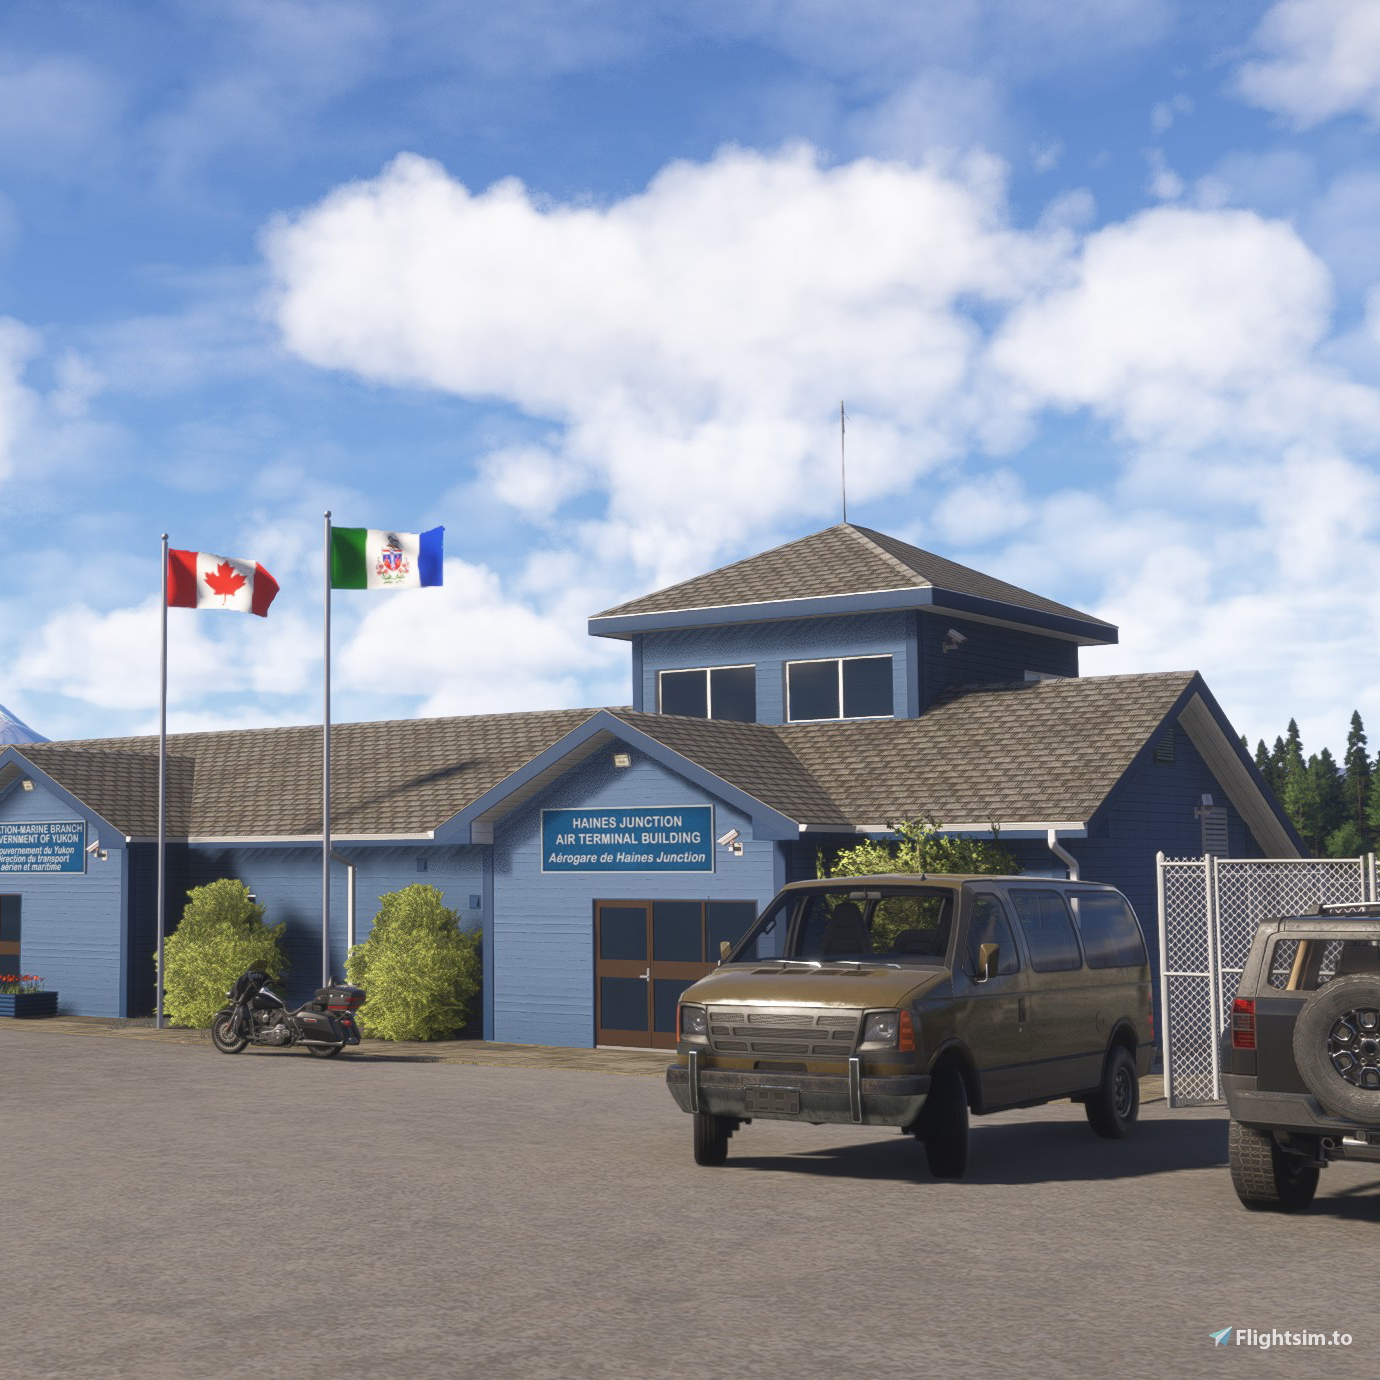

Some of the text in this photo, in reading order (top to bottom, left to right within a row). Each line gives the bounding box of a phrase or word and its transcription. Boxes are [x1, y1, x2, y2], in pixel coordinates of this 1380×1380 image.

[572, 816, 682, 828] HAINES JUNCTION
[50, 824, 82, 833] BRANCH
[40, 834, 50, 843] OF
[52, 834, 78, 843] YUKON
[556, 832, 700, 844] AIR TERMINAL BUILDING
[38, 855, 70, 863] transport
[548, 852, 706, 865] Aérogare de Haines Junction
